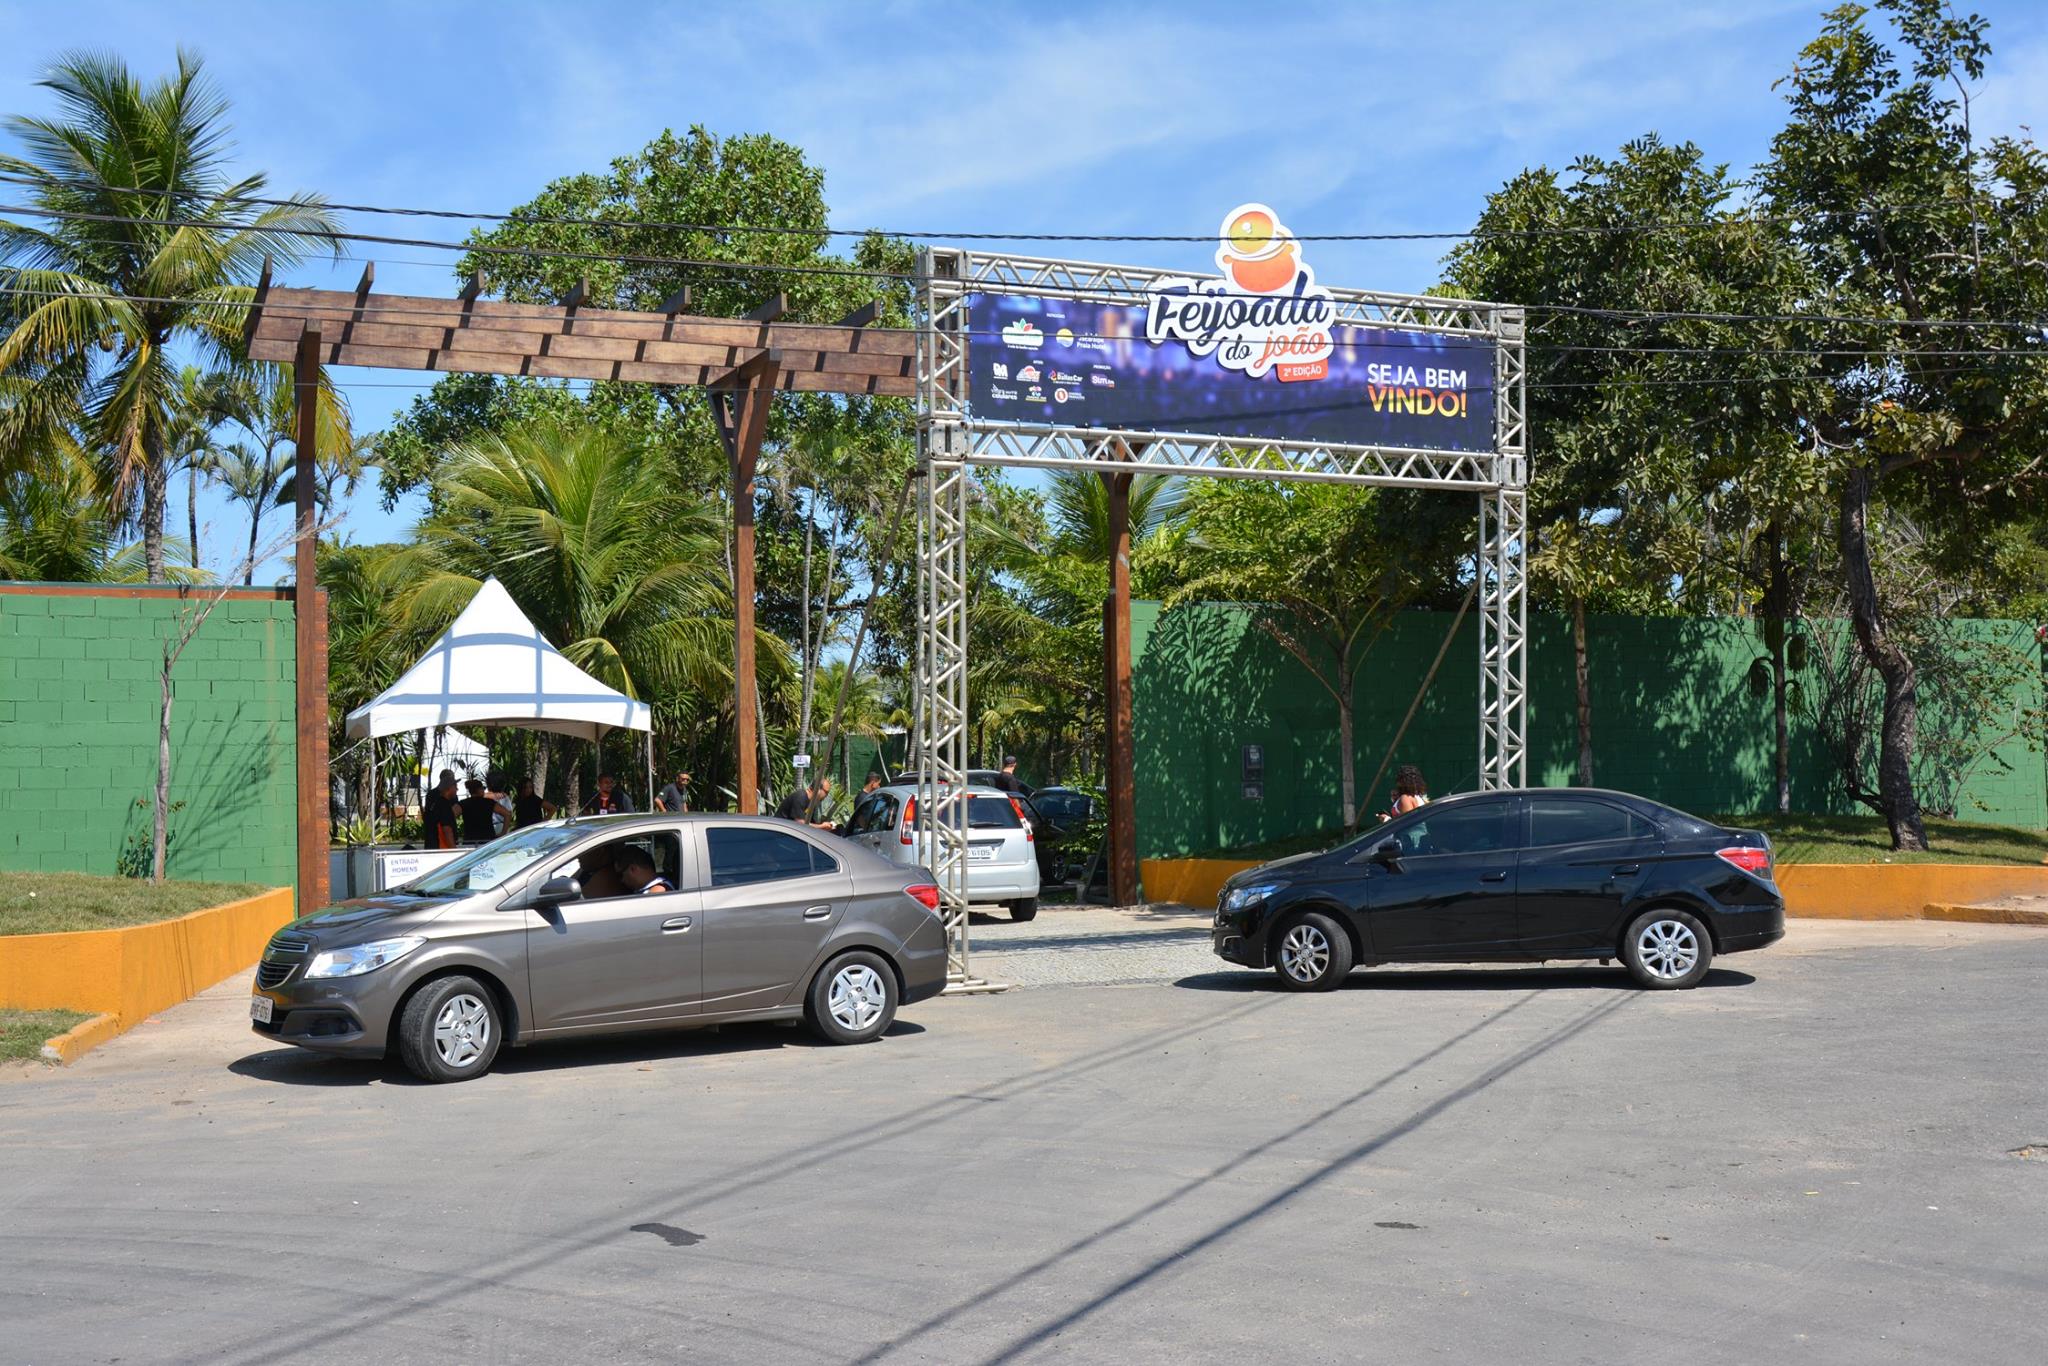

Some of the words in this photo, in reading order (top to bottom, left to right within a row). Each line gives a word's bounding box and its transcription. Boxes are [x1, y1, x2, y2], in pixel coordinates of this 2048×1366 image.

[1154, 270, 1330, 347] Feijoada
[1225, 334, 1252, 360] do
[1253, 327, 1326, 369] joão
[1293, 364, 1322, 377] EDIÇÃO
[1367, 363, 1419, 386] SEJA
[1425, 367, 1467, 389] BEM
[1367, 384, 1467, 418] VINDO!
[391, 858, 419, 866] ENTRADA
[391, 866, 418, 874] HOMENS
